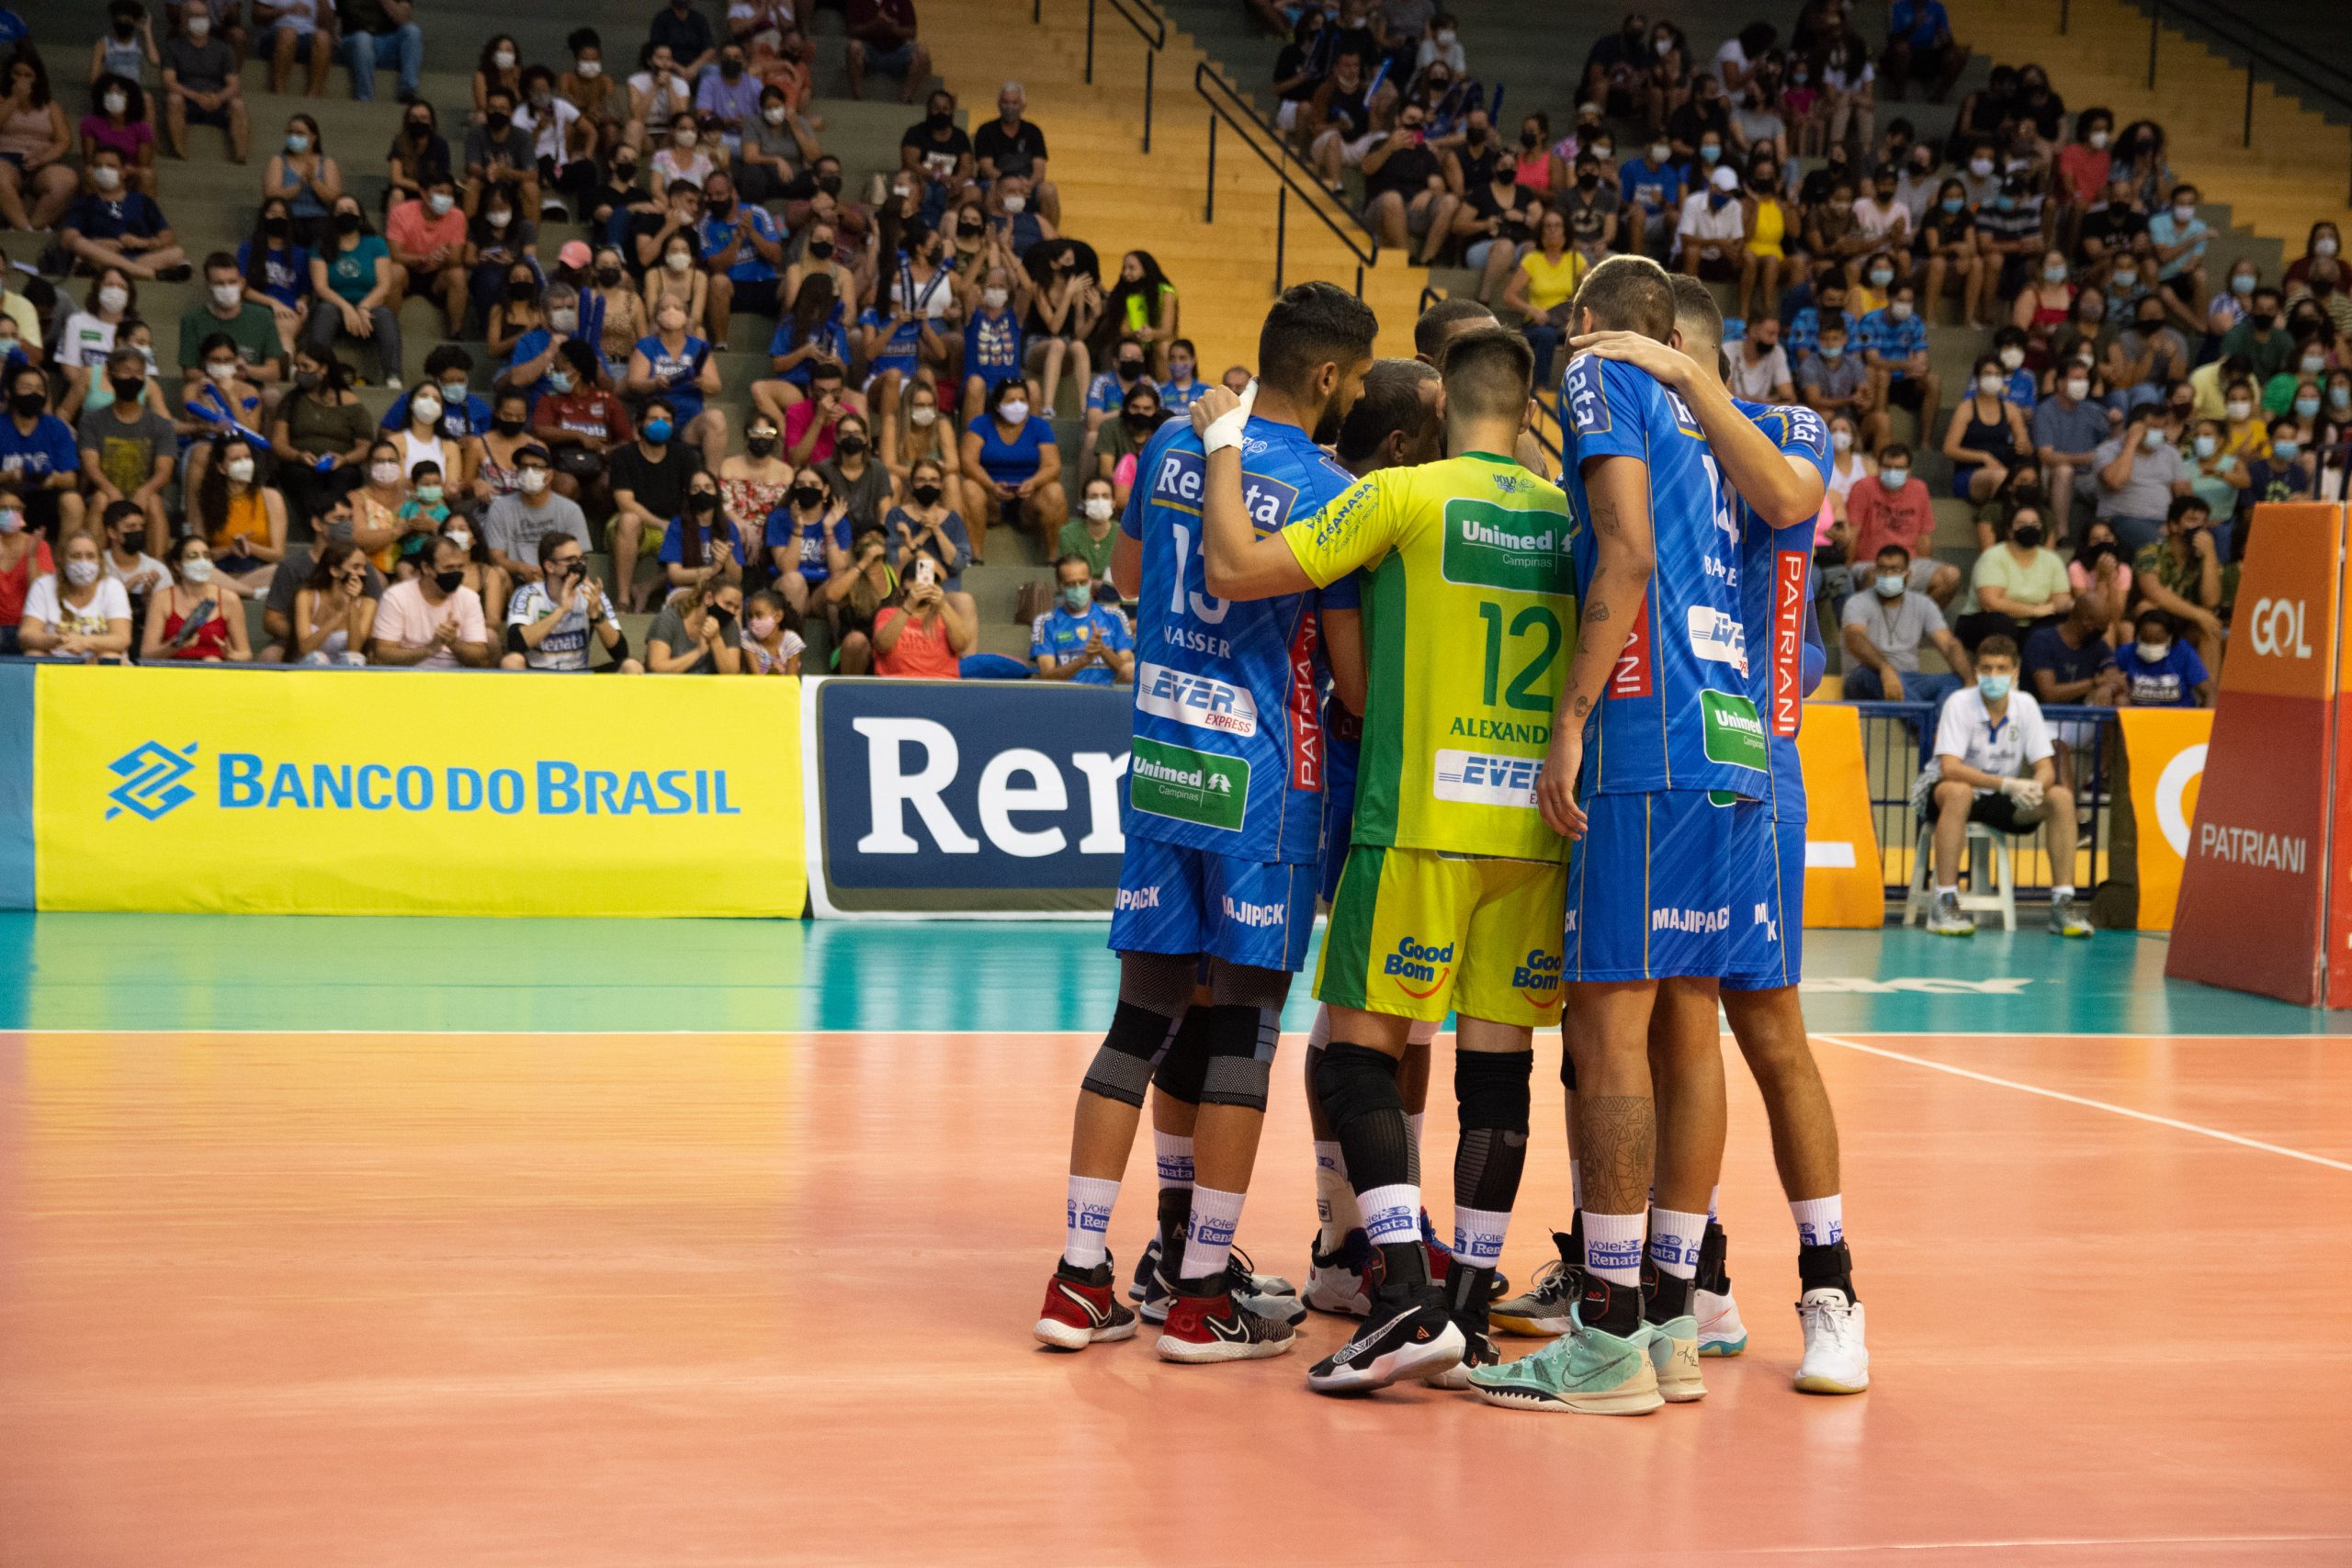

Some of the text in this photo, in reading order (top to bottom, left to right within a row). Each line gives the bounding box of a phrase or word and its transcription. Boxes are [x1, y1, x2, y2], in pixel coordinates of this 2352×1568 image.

[1326, 483, 1374, 535] SANASA
[1462, 519, 1553, 551] Unimed
[1502, 553, 1553, 569] Campinas
[1164, 625, 1232, 660] NASSER
[2251, 596, 2312, 659] GOL
[1479, 601, 1563, 714] 12
[1779, 556, 1803, 733] PATRIANI
[1151, 670, 1237, 715] EVER
[1204, 713, 1252, 734] EXPRESS
[218, 752, 741, 816] BANCO DO BRASIL
[1133, 755, 1203, 787] Unimed
[1159, 784, 1199, 803] Campinas
[2200, 822, 2306, 874] PATRIANI
[1398, 936, 1453, 964] Good
[1384, 953, 1434, 983] Bom
[1511, 966, 1558, 989] Bom
